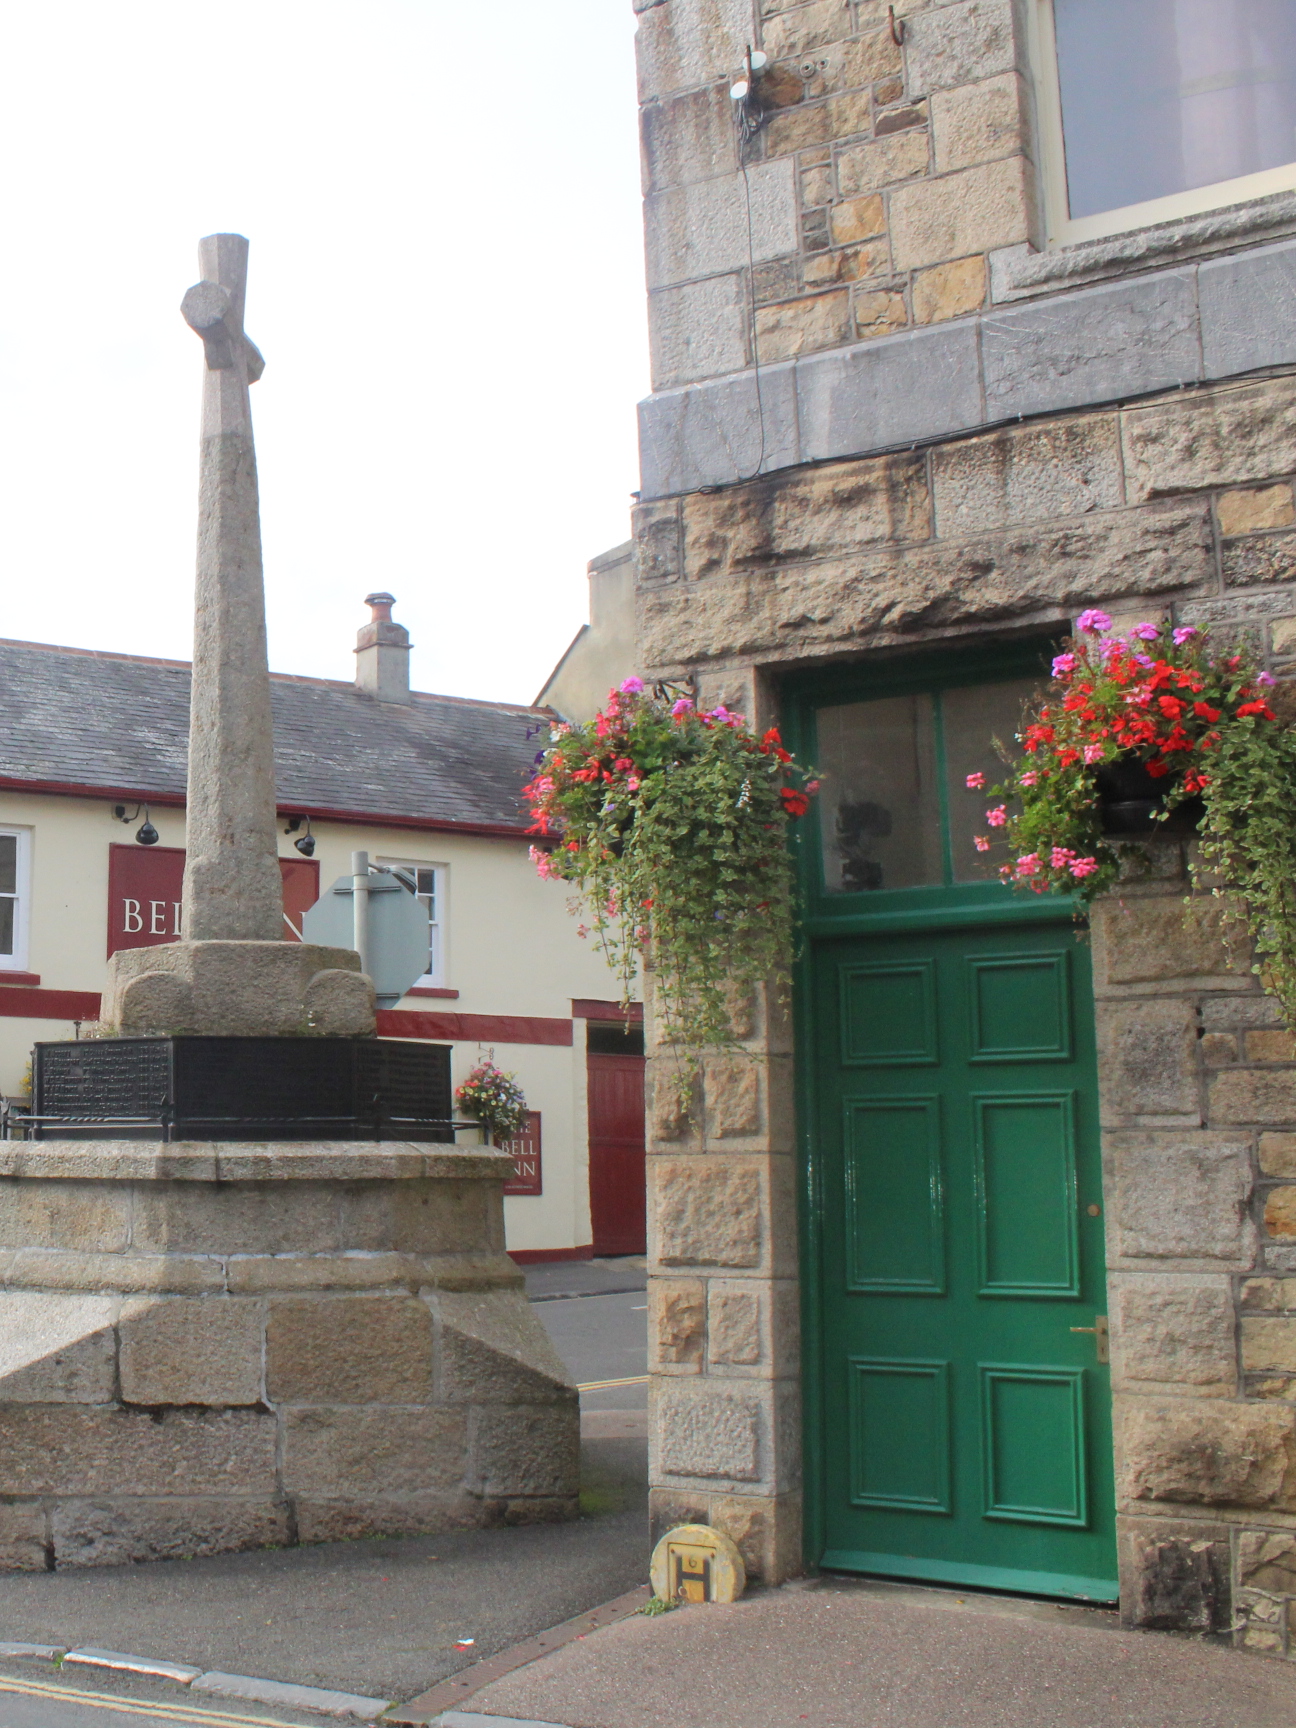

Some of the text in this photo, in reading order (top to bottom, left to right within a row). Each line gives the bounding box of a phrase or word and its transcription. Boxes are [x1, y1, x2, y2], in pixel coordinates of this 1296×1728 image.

[122, 898, 182, 936] BEL
[501, 1140, 537, 1155] BELL
[514, 1161, 536, 1176] NN
[676, 1556, 710, 1602] H
